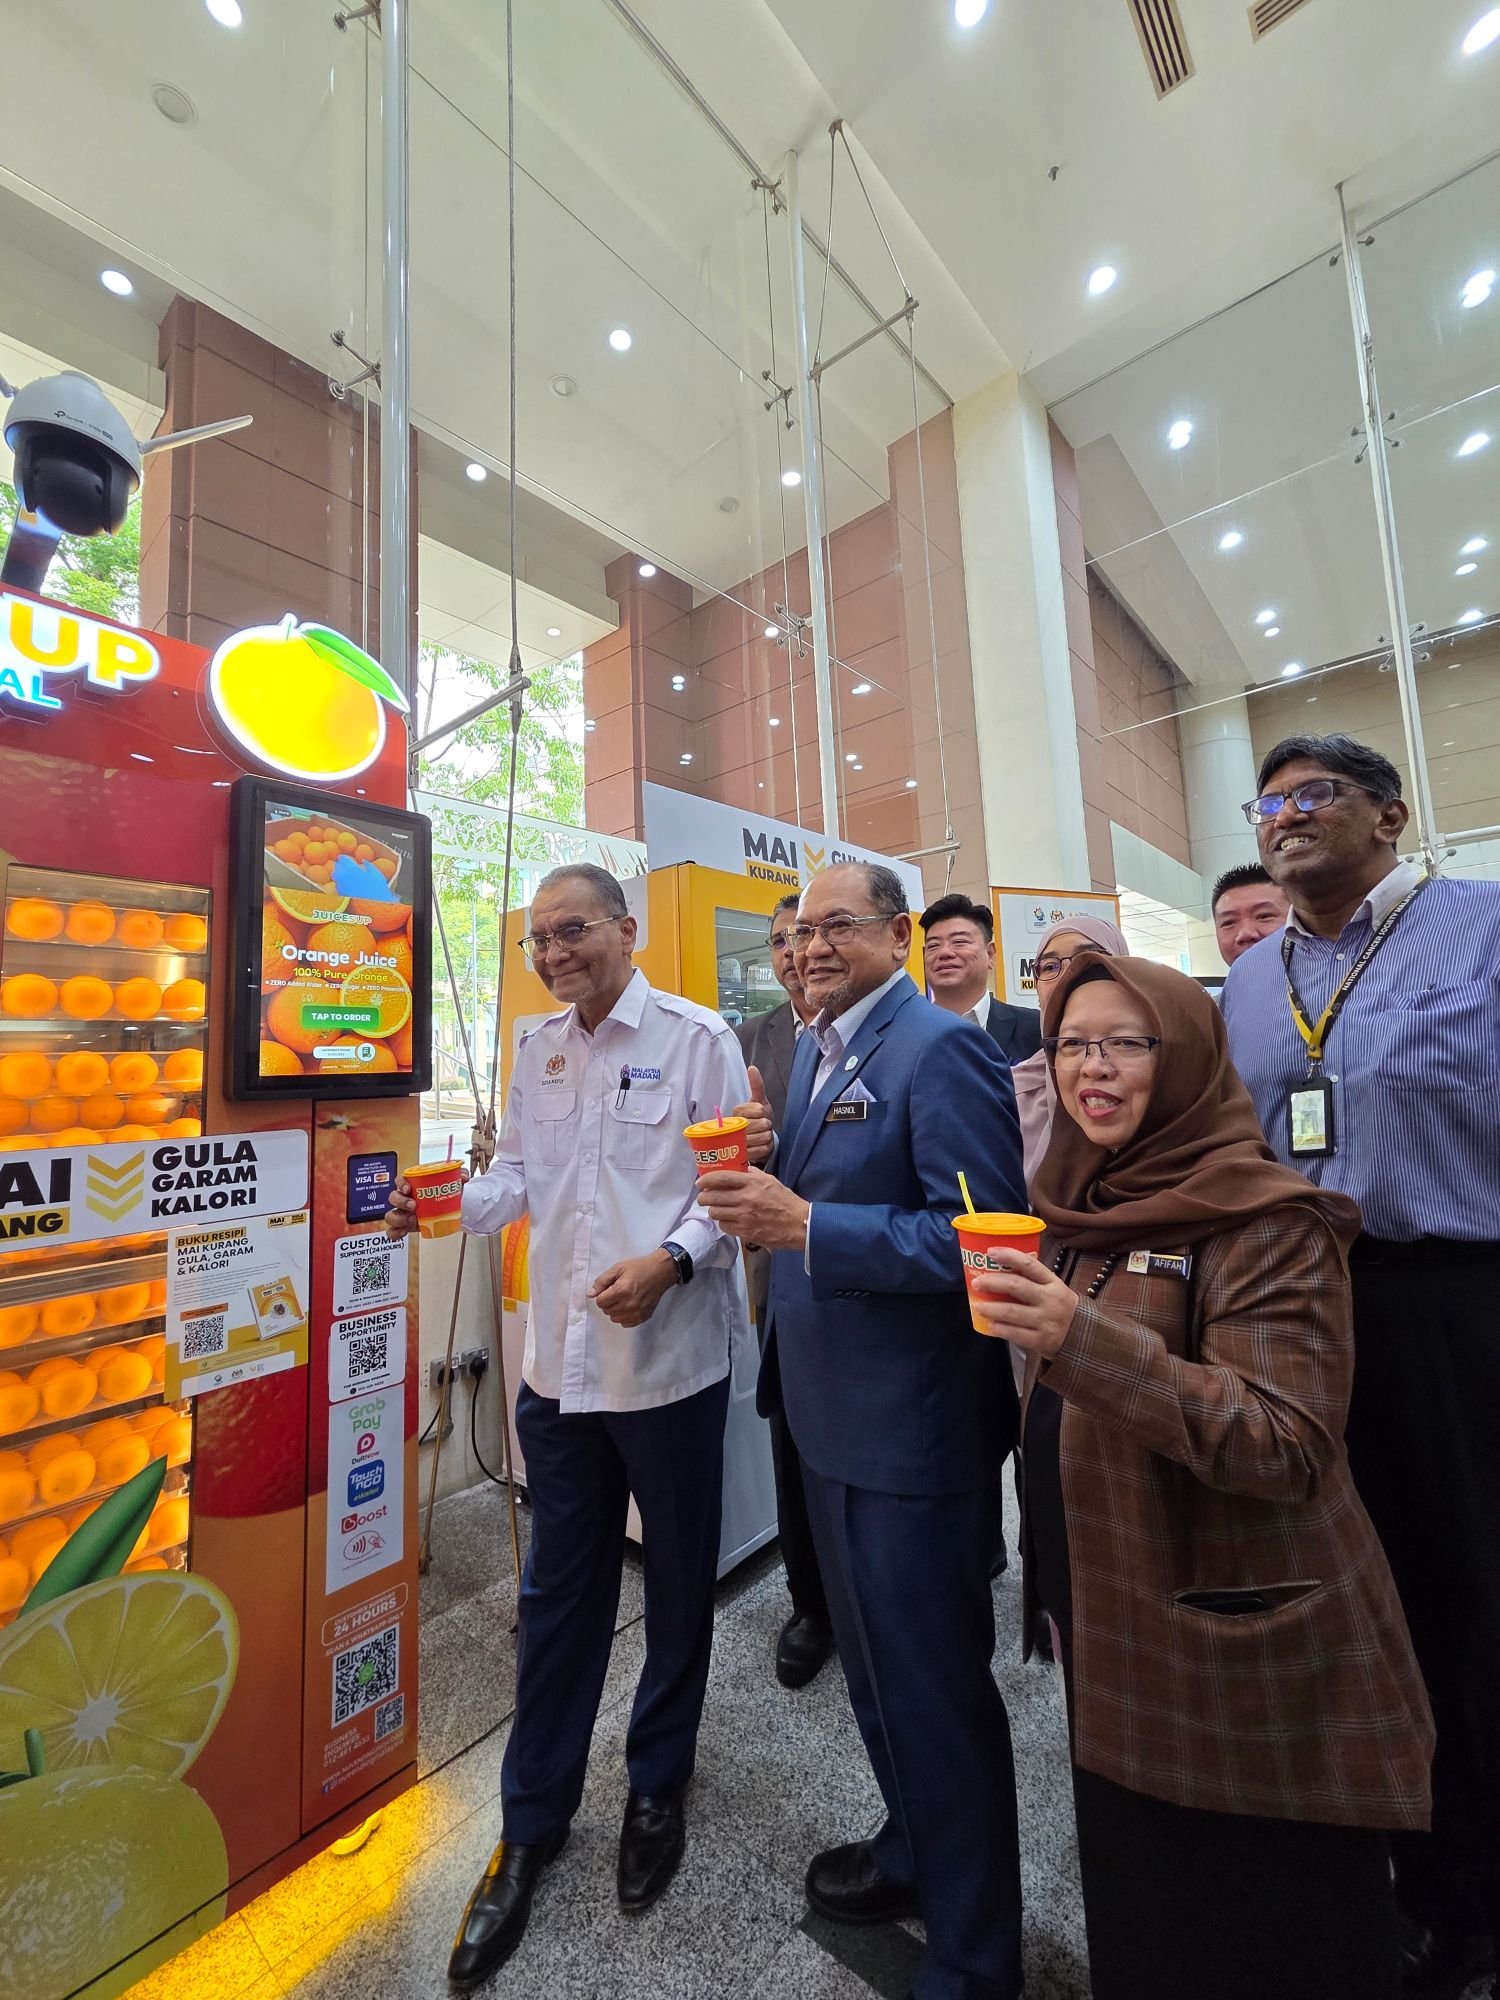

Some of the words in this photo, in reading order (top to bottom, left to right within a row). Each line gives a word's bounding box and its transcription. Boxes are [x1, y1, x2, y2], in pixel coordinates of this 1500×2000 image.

[742, 827, 798, 869] MAI
[749, 865, 799, 887] KURANG
[313, 910, 373, 925] JUICESUP
[281, 945, 350, 966] Orange
[354, 951, 397, 968] Juice
[1342, 960, 1366, 991] NATIONAL
[1362, 935, 1383, 960] CANCER
[1379, 912, 1398, 935] SOCIETY
[293, 968, 321, 978] 100%
[324, 971, 347, 979] Pure
[353, 973, 388, 983] Orange
[312, 1012, 329, 1020] TAP
[630, 1072, 660, 1080] MADANI
[833, 1106, 856, 1114] HASNOL
[152, 1140, 258, 1171] GULA
[151, 1165, 258, 1192] GARAM
[355, 1176, 372, 1184] VISA
[151, 1187, 257, 1217] KALORI
[177, 1233, 209, 1247] BUKU
[211, 1228, 244, 1241] RESIPI
[177, 1245, 200, 1257] MAI
[202, 1237, 249, 1253] KURANG
[381, 1242, 405, 1252] HOURS)
[177, 1253, 211, 1266] GULA,
[213, 1246, 254, 1260] GARAM
[1154, 1259, 1182, 1270] AFIFAH
[177, 1267, 186, 1276] &
[188, 1259, 229, 1274] KALORI
[339, 1311, 397, 1333] BUSINESS
[339, 1321, 397, 1341] OPPORTUNITY
[348, 1397, 386, 1420] Grab
[352, 1415, 381, 1433] Pay
[351, 1451, 380, 1465] DuitNow
[349, 1465, 383, 1485] Touch
[334, 1622, 349, 1637] 24
[352, 1597, 397, 1628] HOURS
[351, 1621, 387, 1643] WHATSAPP
